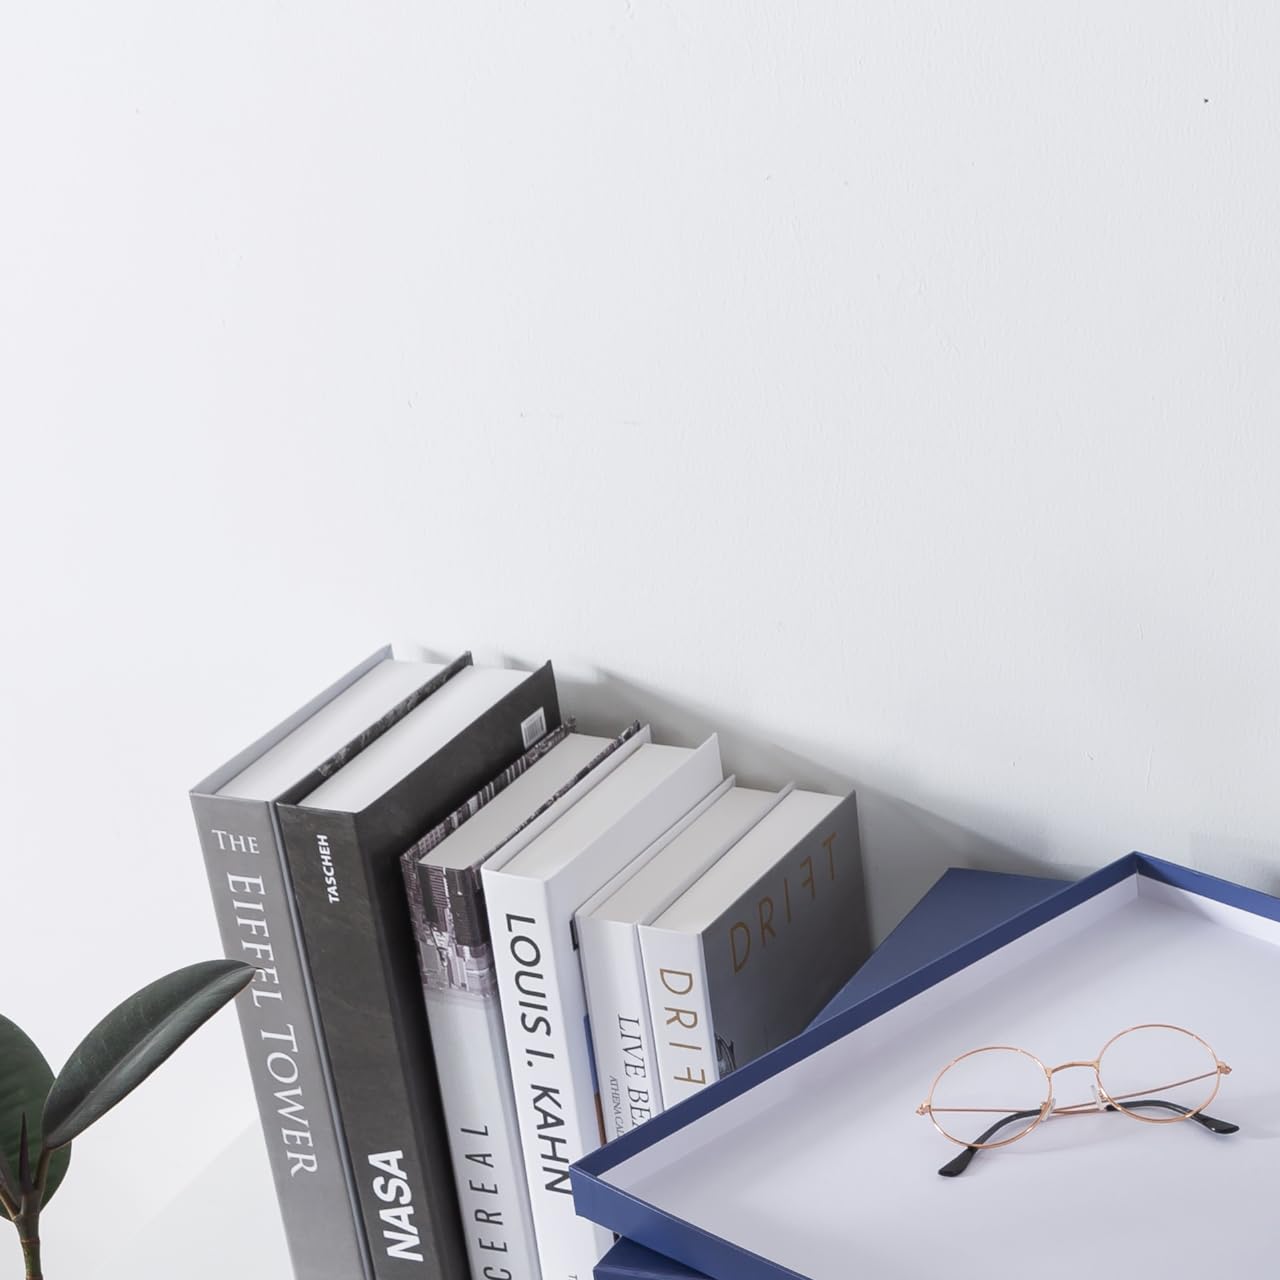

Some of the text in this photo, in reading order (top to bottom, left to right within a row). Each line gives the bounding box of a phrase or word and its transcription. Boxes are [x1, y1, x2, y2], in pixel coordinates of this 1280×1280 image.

[729, 832, 837, 975] DRIFT
[212, 829, 318, 1177] THE EIFFEL TOWER
[506, 913, 551, 1037] LOUIS
[530, 1084, 572, 1195] KAHN
[609, 1075, 622, 1113] ATHENA
[618, 1014, 652, 1128] LIVE BE
[368, 1150, 423, 1263] NASA
